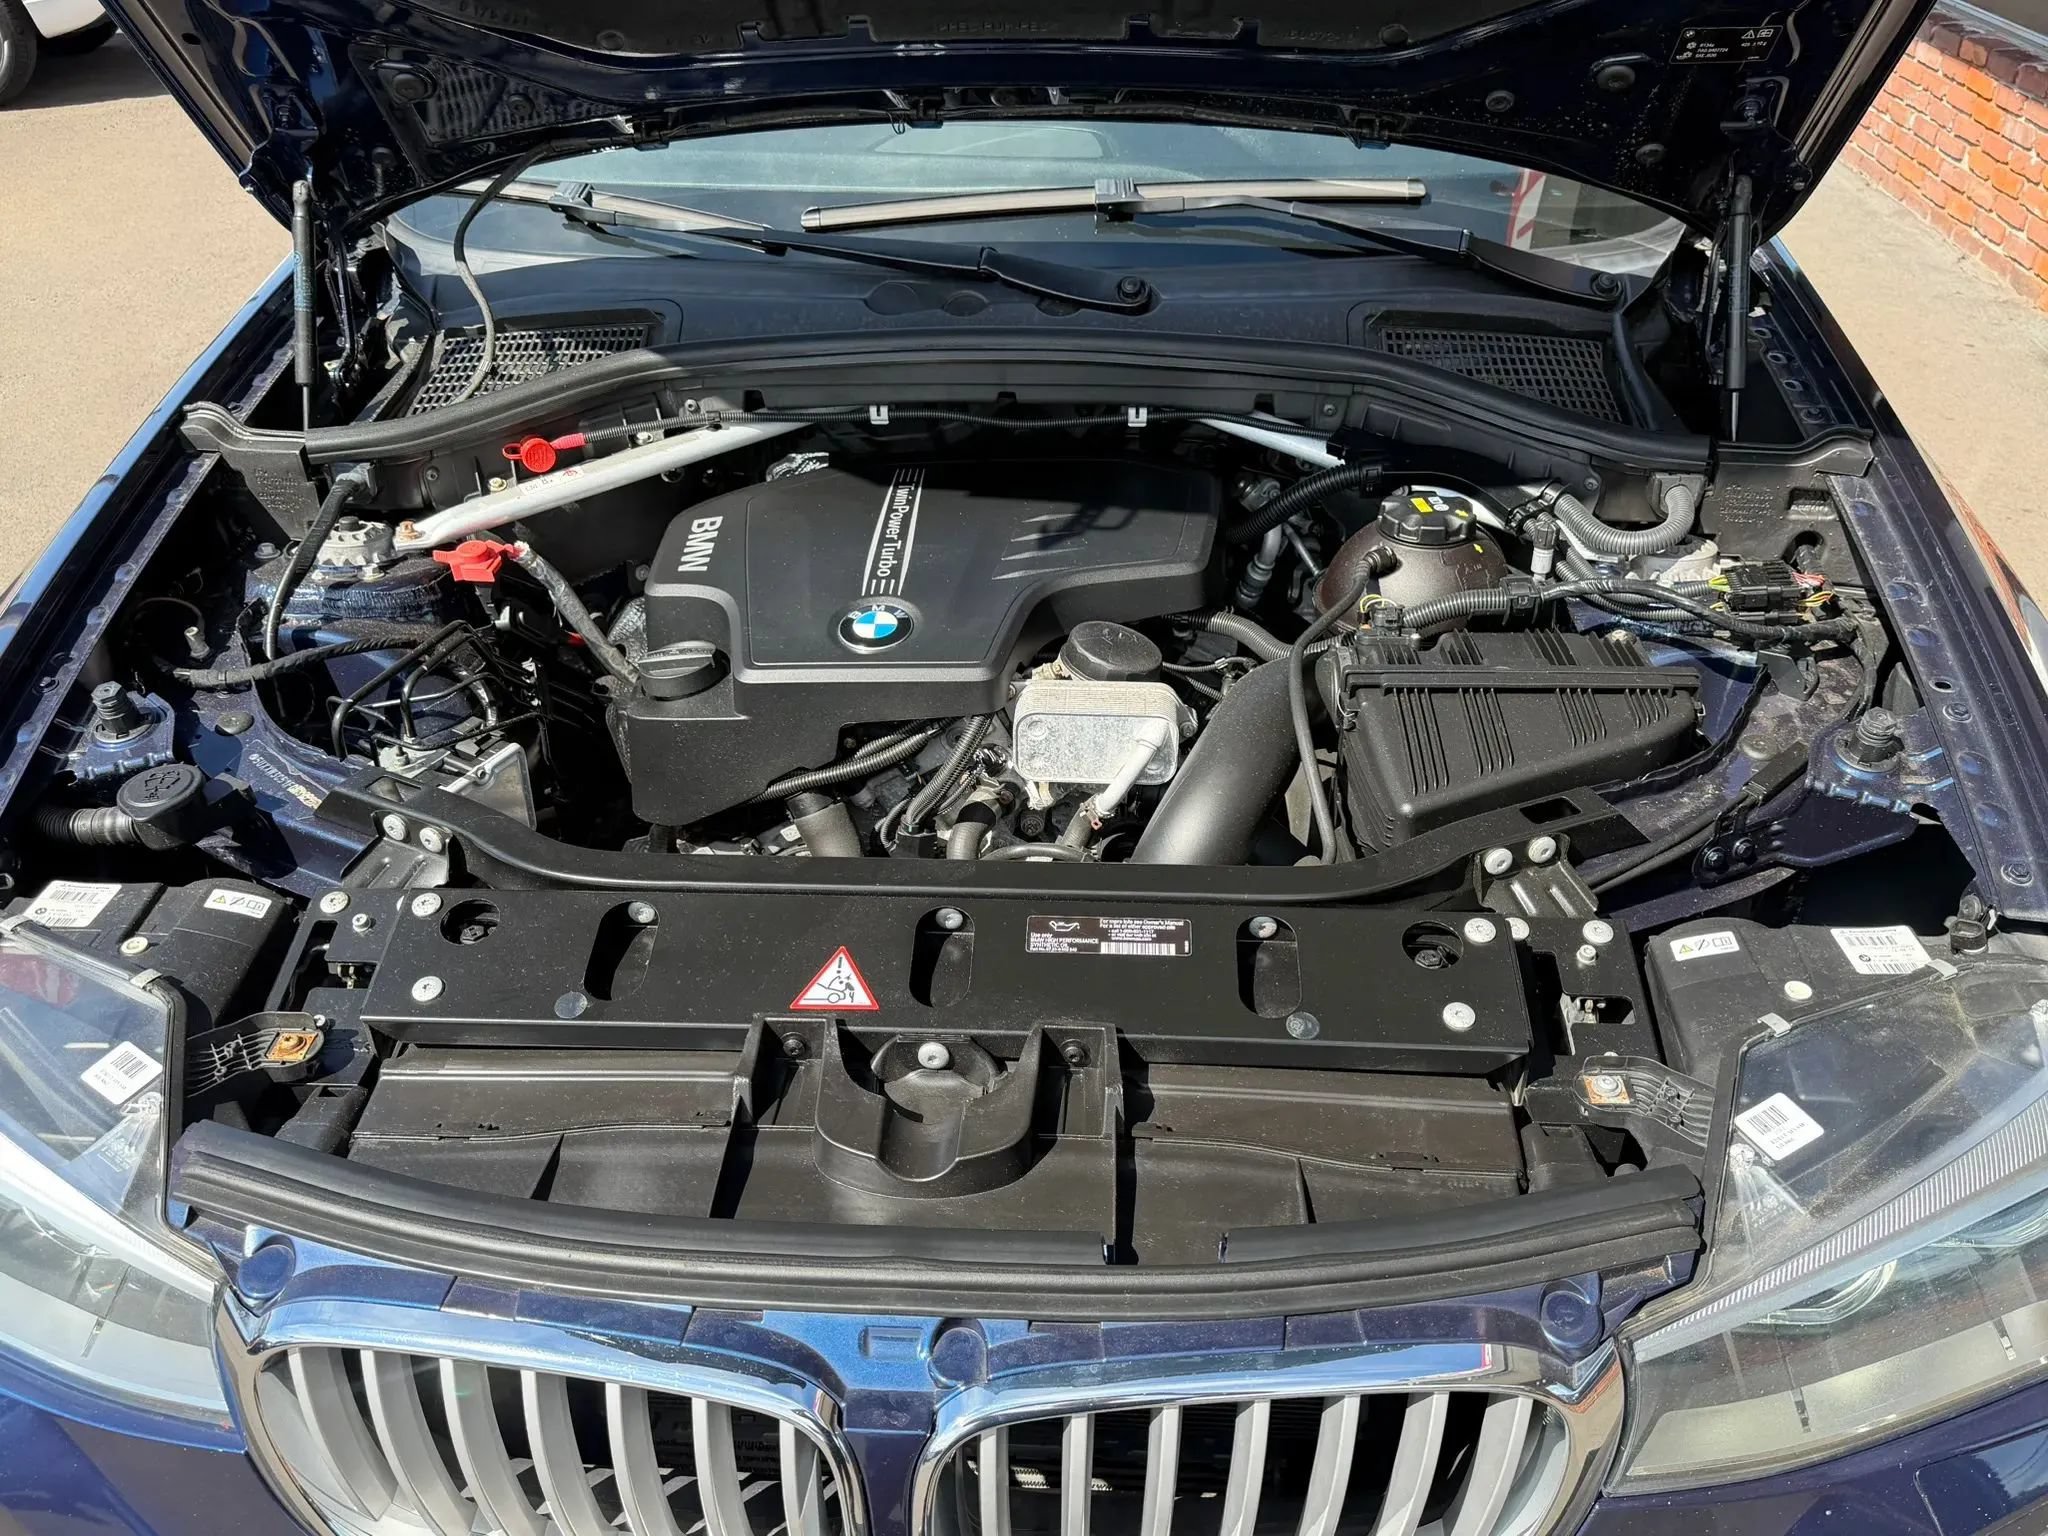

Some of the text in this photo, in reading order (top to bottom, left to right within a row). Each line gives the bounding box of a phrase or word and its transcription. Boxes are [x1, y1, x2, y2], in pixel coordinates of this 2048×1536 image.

[678, 516, 723, 571] BMW
[876, 484, 915, 577] TwinPower Turbo
